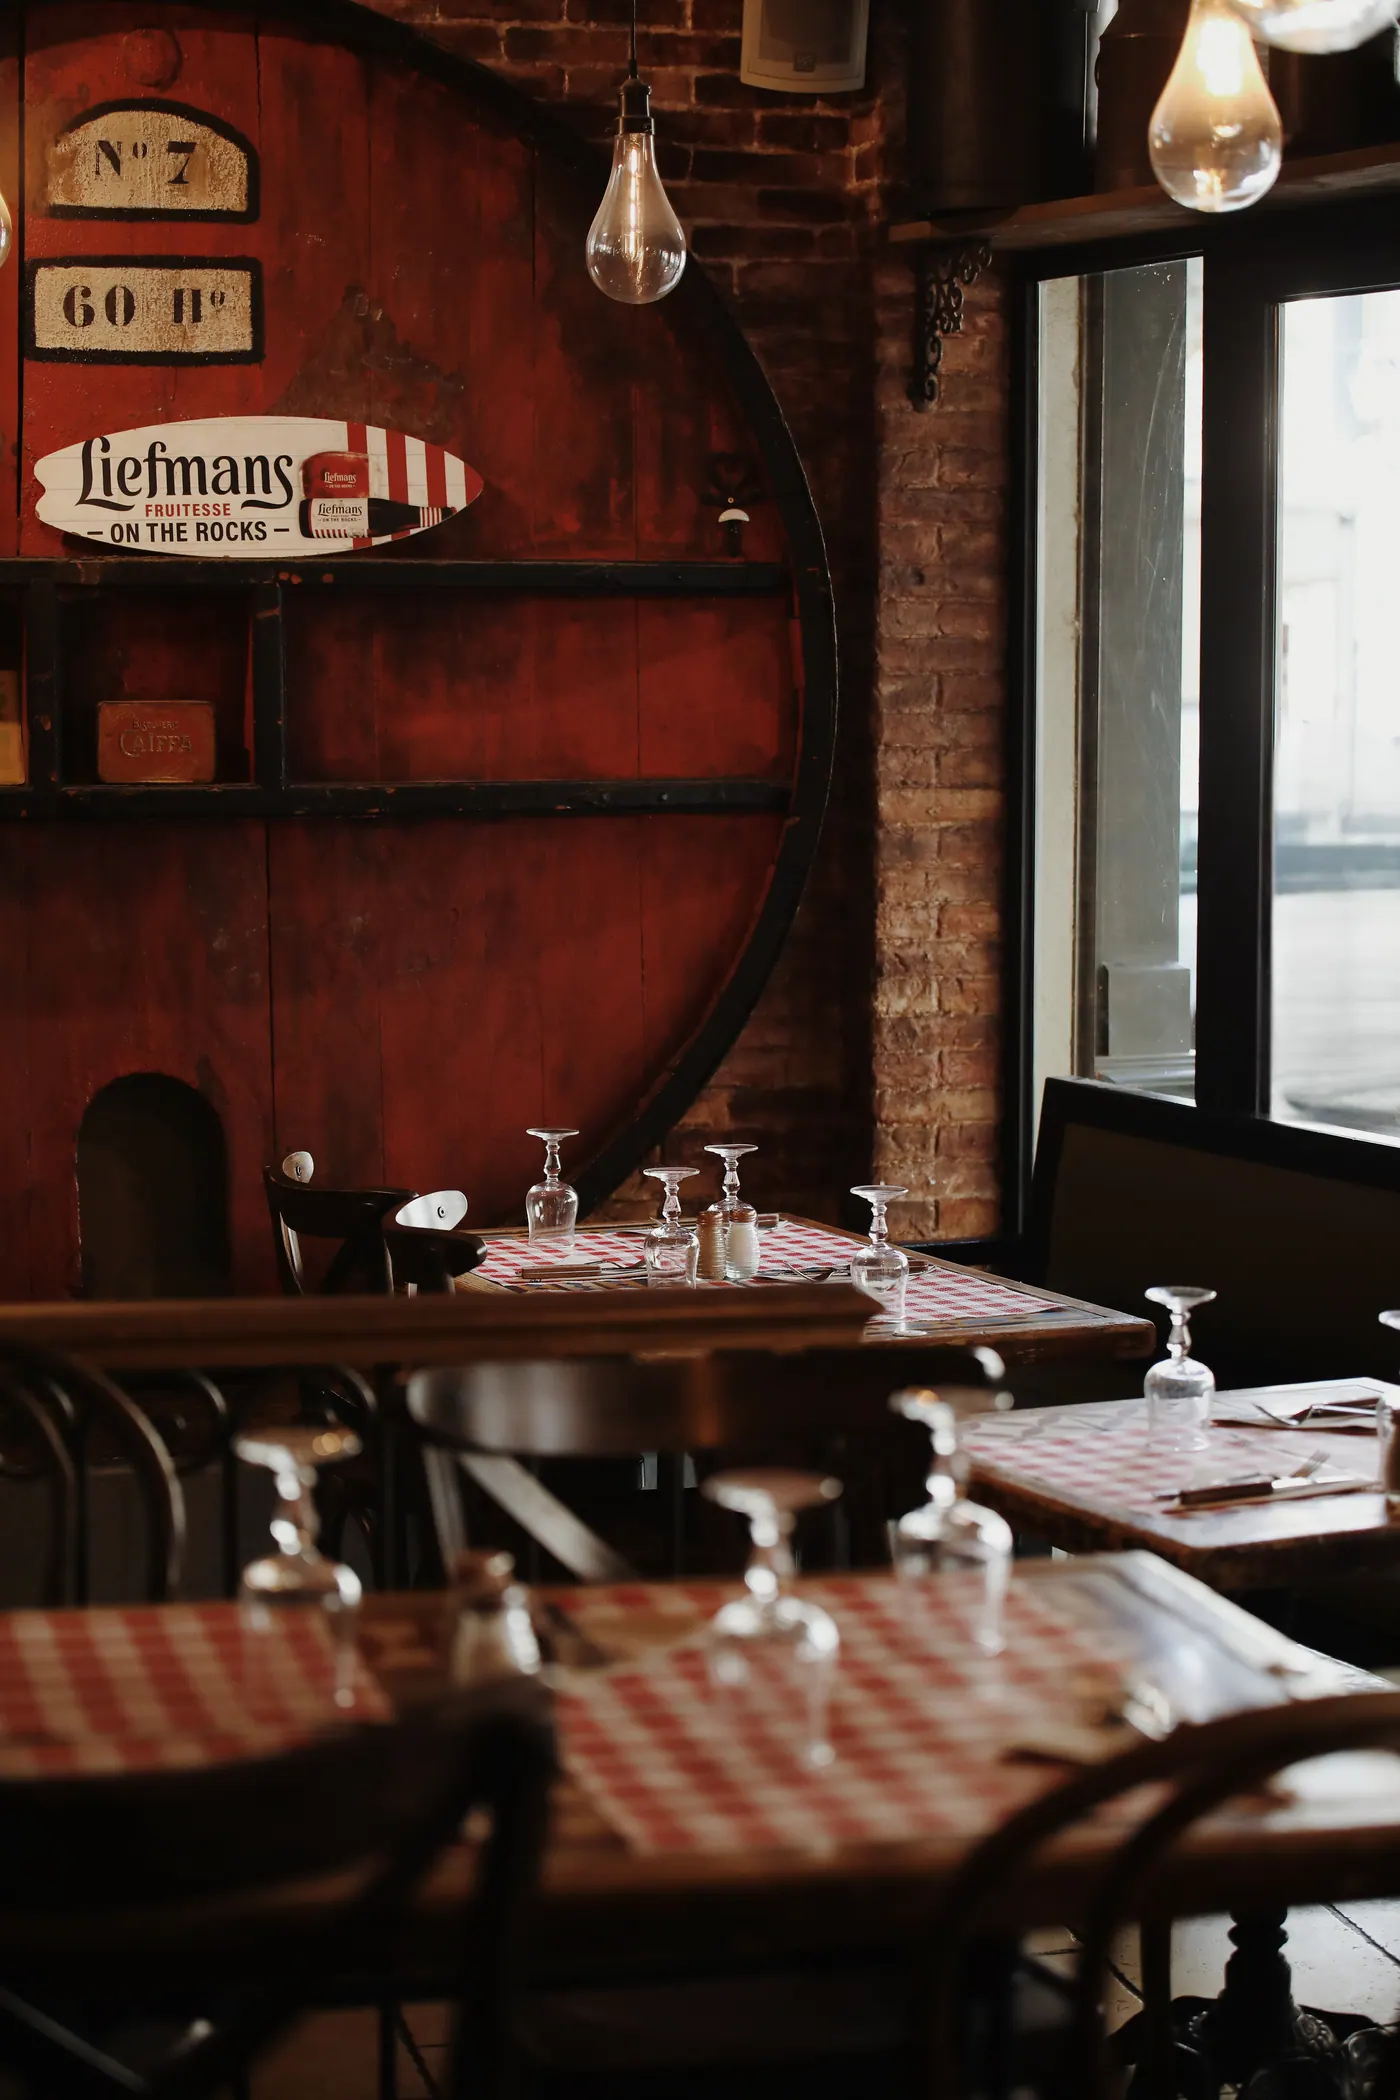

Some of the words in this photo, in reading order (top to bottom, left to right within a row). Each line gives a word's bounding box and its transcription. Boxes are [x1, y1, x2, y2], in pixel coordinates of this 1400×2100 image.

[166, 140, 197, 185] 7
[62, 284, 136, 328] 60
[74, 436, 294, 512] Liefmans
[324, 471, 357, 484] Liefmans
[145, 503, 231, 518] FRUITESSE
[318, 503, 363, 517] Liefmans
[110, 522, 139, 543] ON
[146, 522, 188, 543] THE
[195, 520, 268, 542] ROCKS
